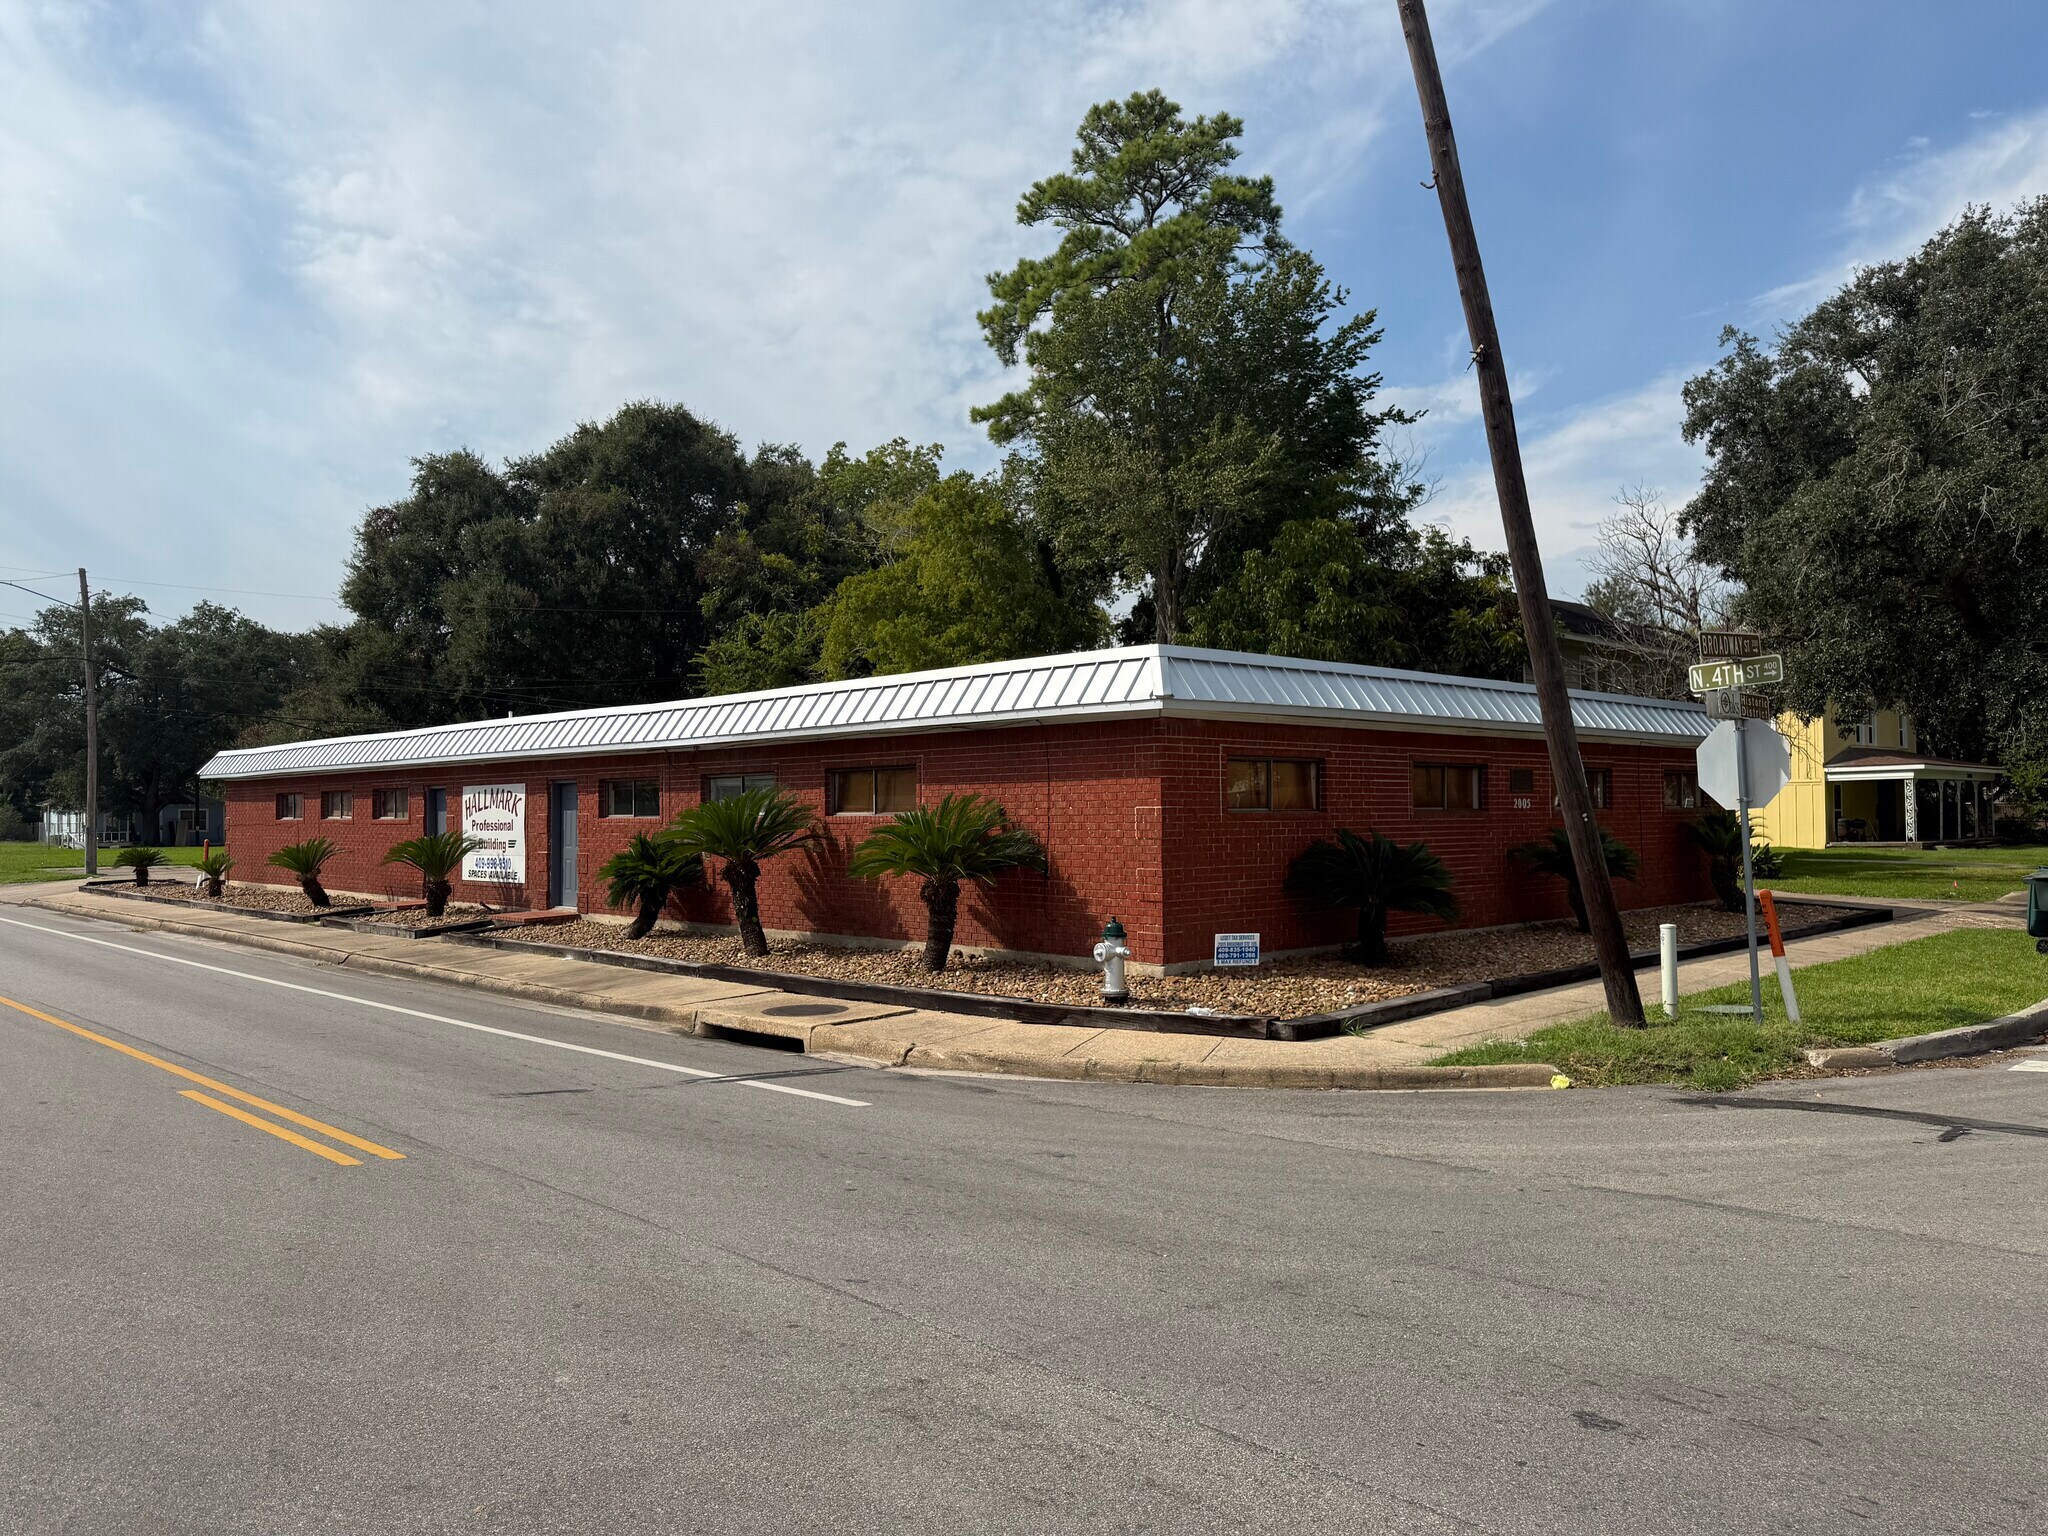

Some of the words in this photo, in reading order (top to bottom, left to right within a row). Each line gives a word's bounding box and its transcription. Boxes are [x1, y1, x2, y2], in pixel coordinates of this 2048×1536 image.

[1701, 635, 1742, 655] BROADWAY
[1743, 640, 1750, 653] ST
[1692, 669, 1709, 688] N.
[1711, 664, 1744, 686] 4TH
[1746, 664, 1760, 678] ST
[1763, 661, 1777, 670] 400
[1740, 693, 1767, 709] Historic
[1741, 706, 1767, 719] District
[465, 787, 522, 821] HALLMARK
[1513, 798, 1531, 809] 2005
[471, 819, 514, 831] Professional
[478, 838, 506, 853] Building
[468, 869, 487, 879] SPACES
[488, 870, 518, 880] AVAILABLE
